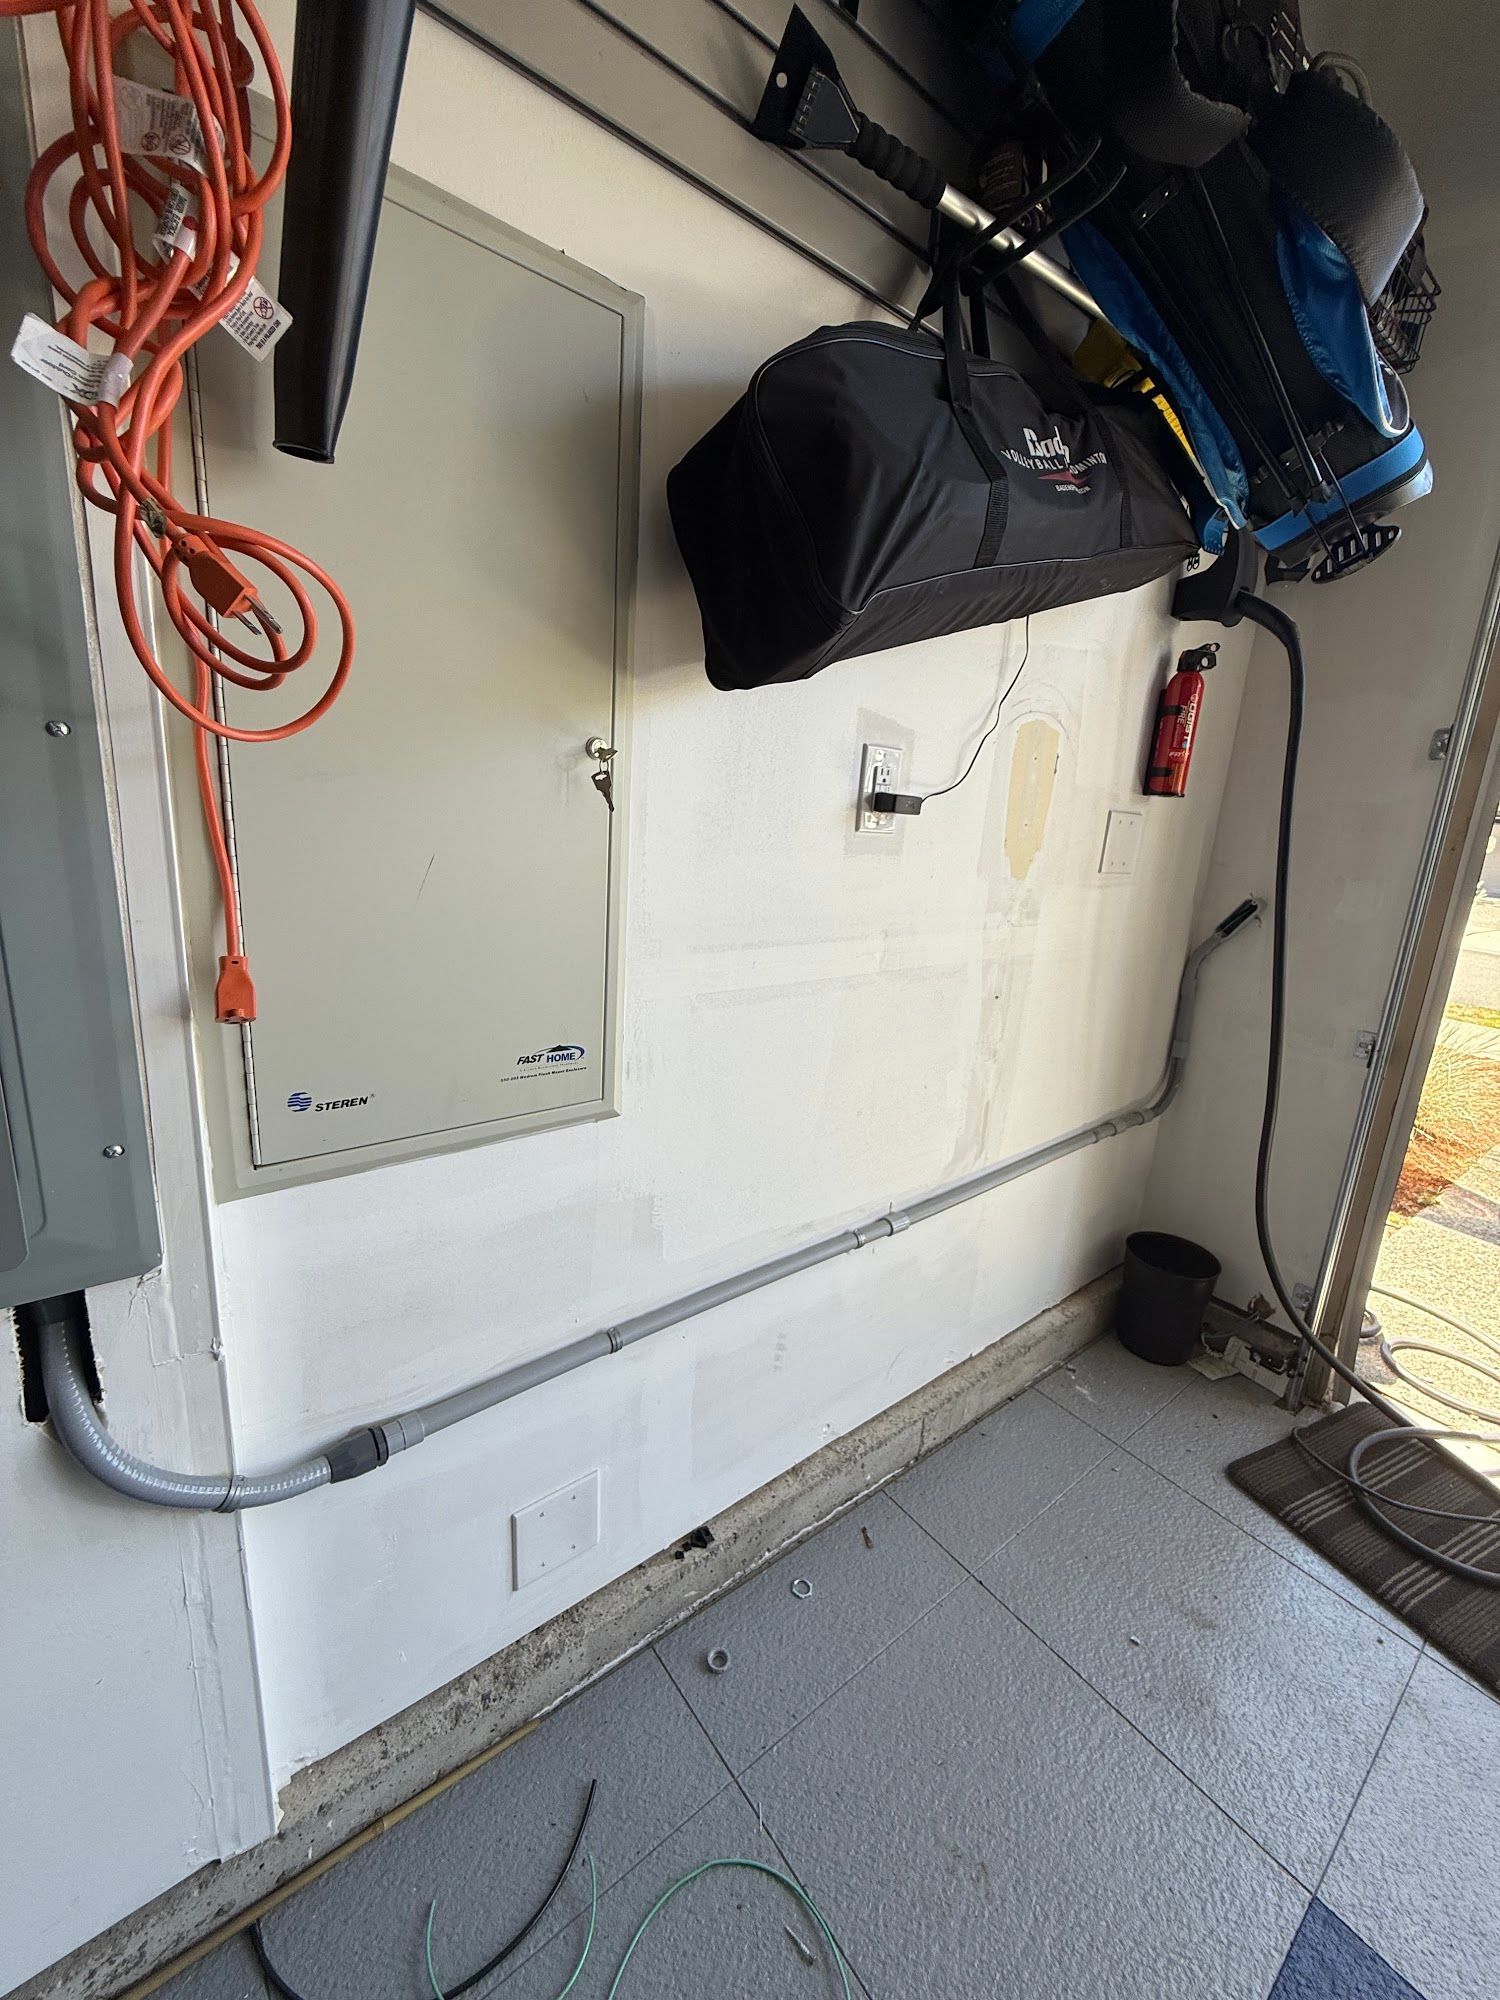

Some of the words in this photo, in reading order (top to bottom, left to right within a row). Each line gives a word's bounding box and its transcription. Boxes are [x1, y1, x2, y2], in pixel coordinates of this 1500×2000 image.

[516, 1053, 545, 1065] FAST
[546, 1051, 576, 1064] HOME
[314, 1096, 369, 1112] STEREN
